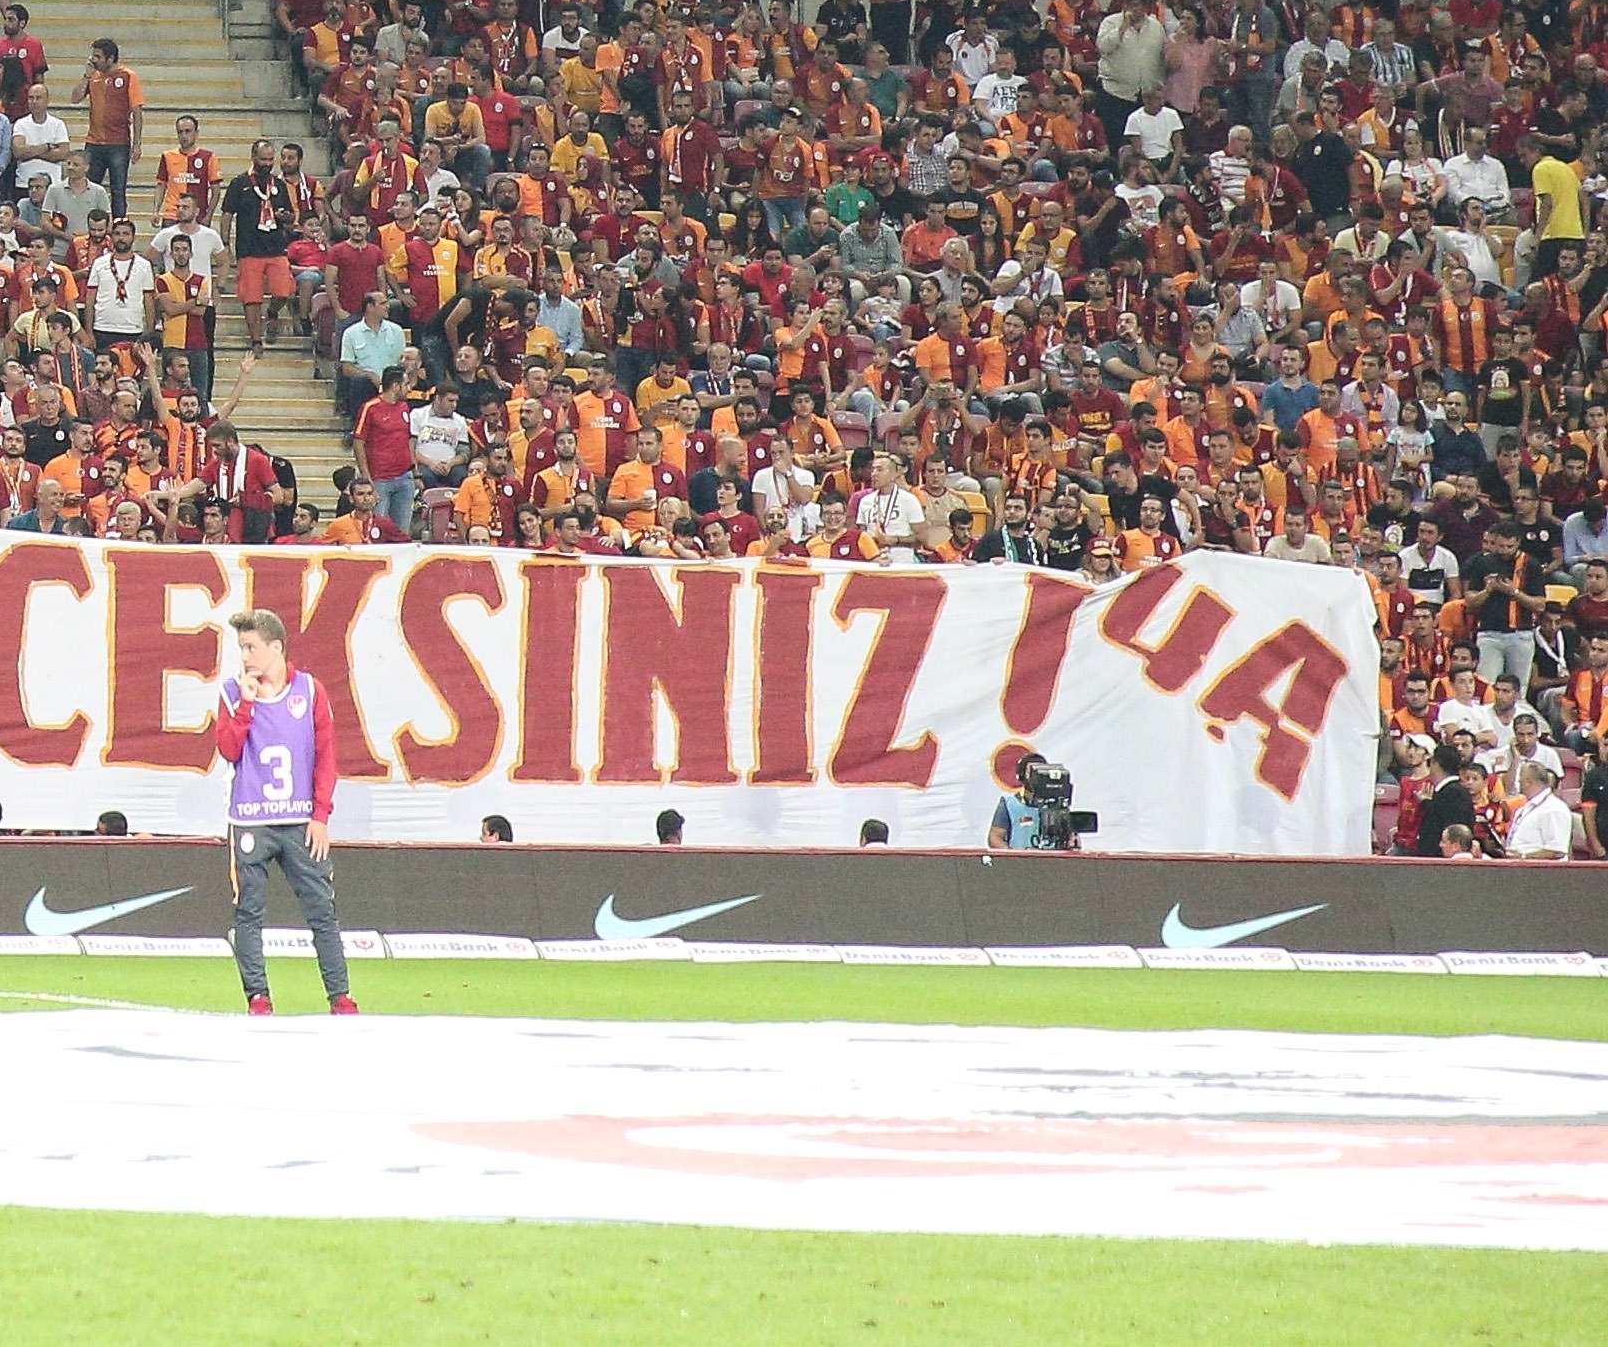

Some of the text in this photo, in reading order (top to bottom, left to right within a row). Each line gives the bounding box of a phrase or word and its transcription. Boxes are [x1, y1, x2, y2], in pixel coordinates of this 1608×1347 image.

[773, 168, 794, 181] nef
[258, 744, 294, 801] 3
[236, 802, 261, 817] TOP
[1450, 954, 1558, 967] DenizBank
